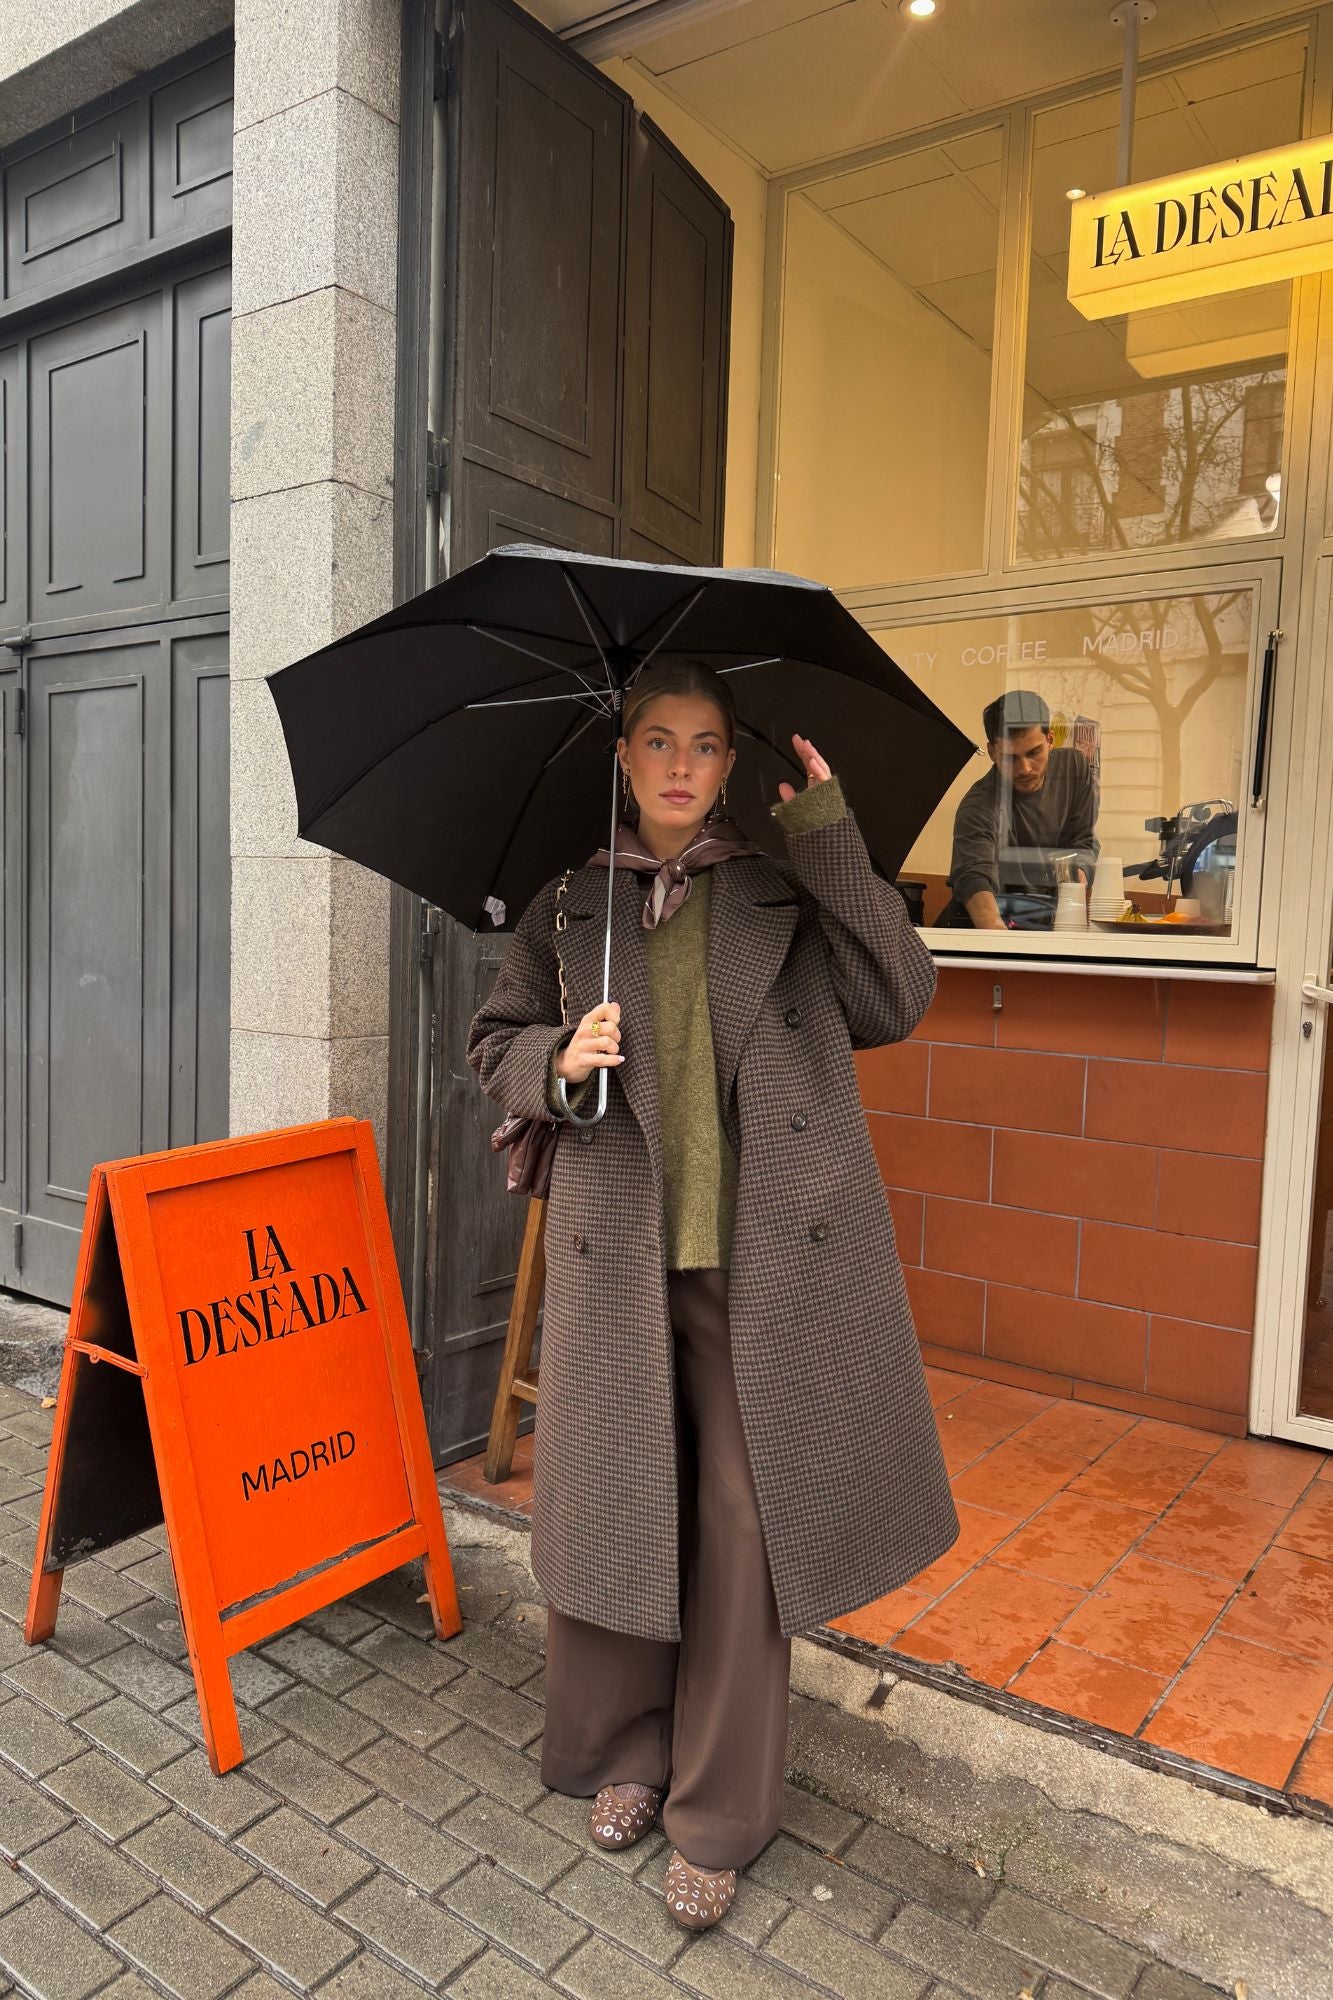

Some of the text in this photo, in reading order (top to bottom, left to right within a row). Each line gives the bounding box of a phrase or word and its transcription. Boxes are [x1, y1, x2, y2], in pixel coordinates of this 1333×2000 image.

[1090, 210, 1145, 268] LA
[895, 628, 1179, 671] LTY COFEE MADRID
[241, 1225, 296, 1283] LA
[176, 1266, 370, 1366] DESEADA
[241, 1430, 356, 1500] MADRID
